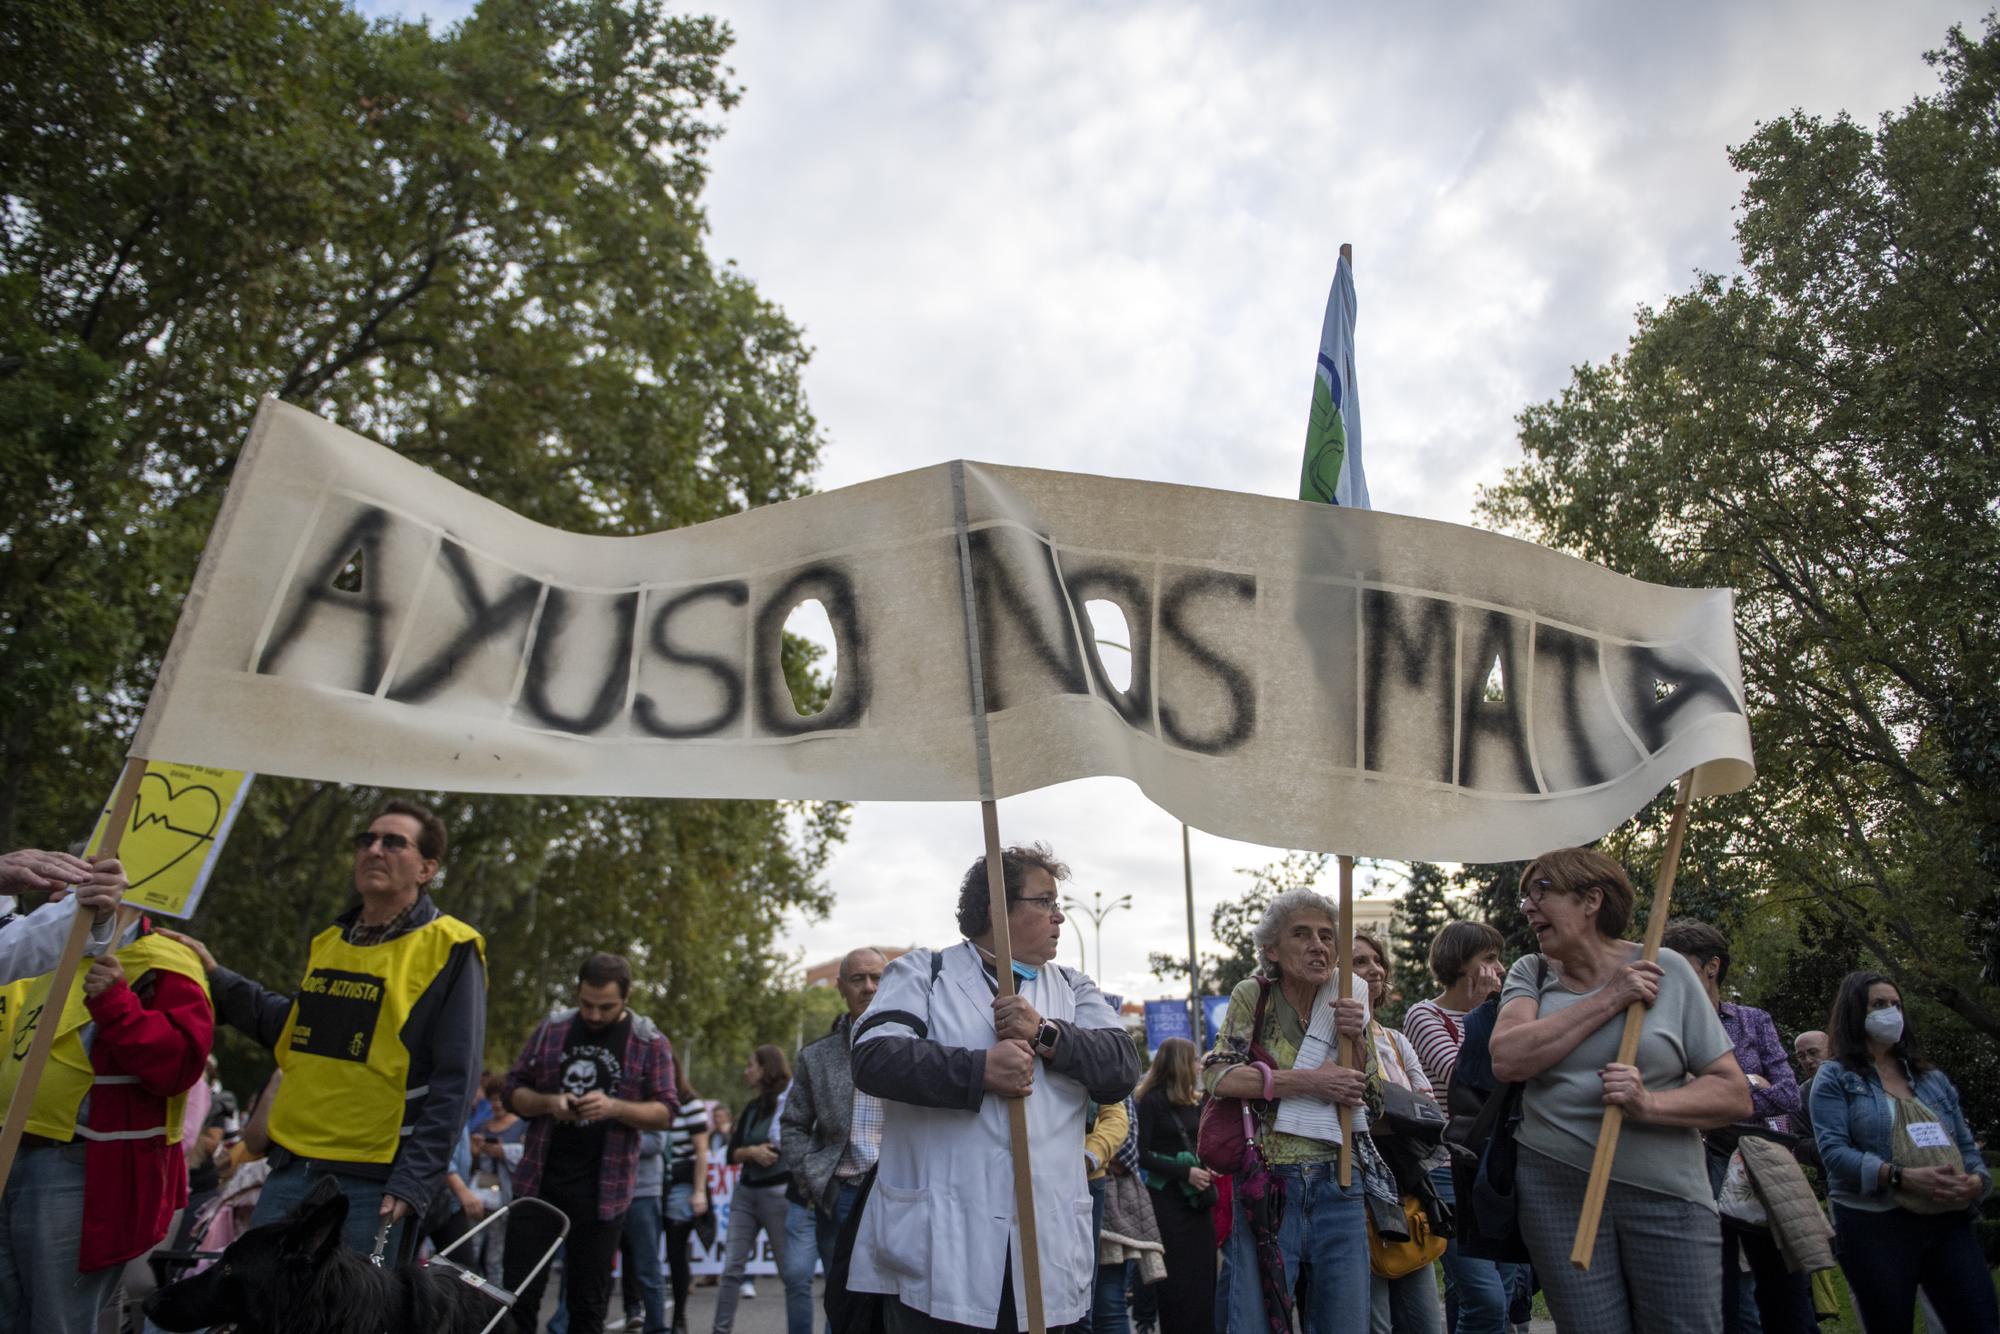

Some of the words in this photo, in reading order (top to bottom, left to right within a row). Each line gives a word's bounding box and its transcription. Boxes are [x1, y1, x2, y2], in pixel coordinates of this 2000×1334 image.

[256, 503, 873, 738] AYUSO
[968, 528, 1257, 756] NOS
[1364, 587, 1744, 796] MATA
